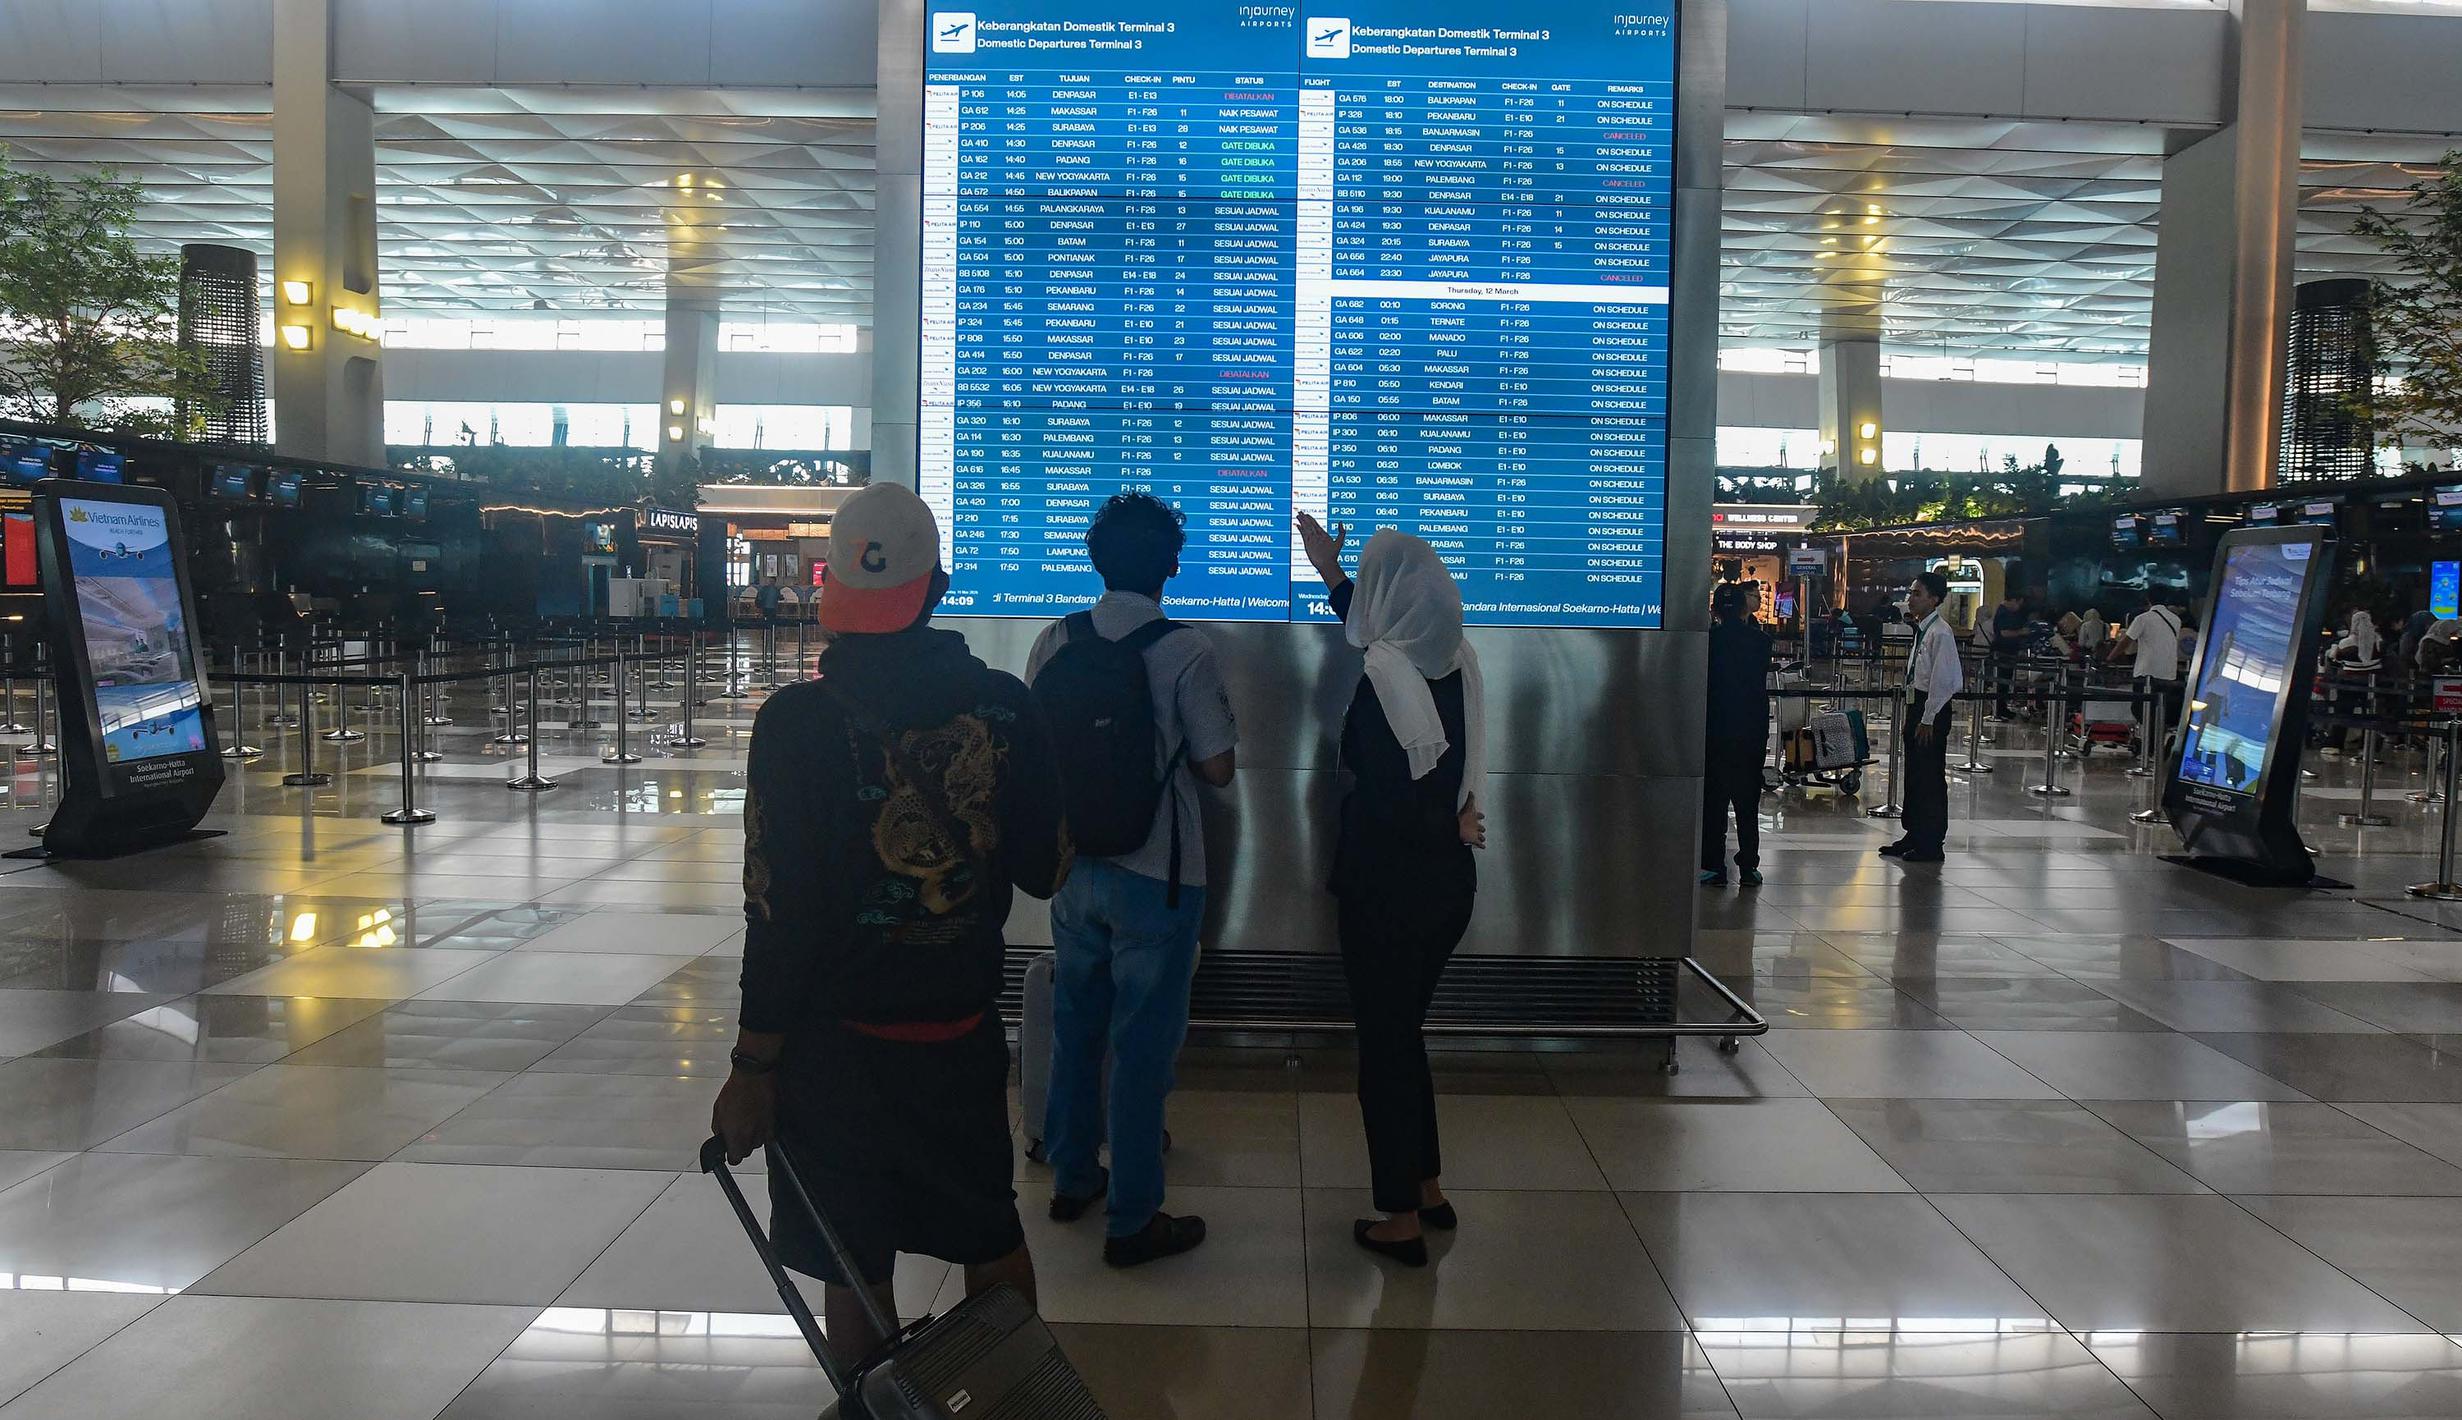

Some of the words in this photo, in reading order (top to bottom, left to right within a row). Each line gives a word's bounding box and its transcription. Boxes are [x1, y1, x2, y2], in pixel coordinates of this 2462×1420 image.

[977, 21, 1061, 33] Keberangkatan
[1063, 21, 1115, 32] Domestik
[1118, 22, 1165, 33] Terminal
[1167, 23, 1175, 33] 3
[1351, 26, 1436, 39] Keberangkatan
[1438, 28, 1490, 39] Domestik
[1493, 29, 1540, 40] Terminal
[1541, 30, 1550, 40] 3
[1615, 29, 1666, 37] AIRPORTS
[977, 38, 1026, 48] Domestic
[1028, 39, 1087, 50] Departures
[1089, 39, 1132, 49] Terminal
[1134, 40, 1142, 49] 3
[1351, 44, 1400, 54] Domestic
[1403, 45, 1461, 56] Departures
[1463, 46, 1507, 56] Terminal
[1509, 47, 1517, 57] 3
[1009, 74, 1024, 82] EST
[1428, 81, 1476, 89] DESTINATION
[1608, 85, 1644, 93] REMARKS
[1052, 91, 1096, 99] DENPASAR
[1427, 96, 1476, 104] BALIKPAPAN
[1597, 100, 1610, 108] ON
[1611, 101, 1653, 109] SCHEDULE
[1051, 107, 1097, 115] MAKASSAR
[1219, 109, 1238, 117] NAIK
[1240, 109, 1278, 117] PESAWAT
[1427, 112, 1476, 120] PEKANBARU
[1052, 123, 1095, 131] SURABAYA
[1423, 128, 1480, 136] BANJARMASIN
[1052, 140, 1095, 148] DENPASAR
[1430, 144, 1472, 152] DENPASAR
[1056, 156, 1090, 164] PADANG
[1435, 160, 1487, 168] YOGYAKARTA
[1036, 172, 1056, 180] NEW
[1057, 172, 1110, 180] YOGYAKARTA
[1426, 176, 1475, 184] PALEMBANG
[1040, 205, 1104, 213] PALANGKARAYA
[1424, 207, 1475, 215] KUALANAMU
[1050, 221, 1094, 229] DENPASAR
[1428, 223, 1471, 231] DENPASAR
[1428, 239, 1470, 247] SURABAYA
[1048, 254, 1095, 262] PONTIANAK
[1050, 270, 1093, 278] DENPASAR
[1428, 270, 1469, 278] JAYAPURA
[1046, 286, 1096, 294] PEKANBARU
[1047, 303, 1094, 311] SEMARANG
[1431, 302, 1465, 310] SORONG
[1046, 319, 1096, 327] PEKANBARU
[1213, 321, 1242, 329] SESUAI
[1243, 322, 1277, 330] JADWAL
[1431, 318, 1465, 326] TERNATE
[1047, 335, 1094, 343] MAKASSAR
[1048, 352, 1092, 360] DENPASAR
[1437, 349, 1457, 357] PALU
[1606, 353, 1647, 361] SCHEDULE
[1002, 367, 1023, 375] 16:00
[1054, 368, 1107, 376] YOGYAKARTA
[1424, 365, 1469, 373] MAKASSAR
[1032, 384, 1052, 392] NEW
[1054, 384, 1107, 392] YOGYAKARTA
[1429, 381, 1463, 389] KENDARI
[1052, 400, 1087, 408] PADANG
[1377, 413, 1400, 421] 06:00
[1423, 414, 1468, 422] MAKASSAR
[1047, 418, 1090, 426] SURABAYA
[1043, 434, 1094, 442] PALEMBANG
[1420, 430, 1471, 438] KUALANAMU
[1428, 446, 1462, 454] PADANG
[1042, 451, 1094, 459] KUALANAMU
[1416, 477, 1473, 485] BANJARMASIN
[1047, 483, 1089, 491] SURABAYA
[1423, 493, 1465, 501] SURABAYA
[1001, 498, 1020, 506] 17:00
[1046, 499, 1090, 507] DENPASAR
[1420, 509, 1468, 517] PEKANBARU
[87, 511, 127, 525] Vietnam
[128, 514, 160, 528] Airlines
[650, 512, 698, 531] LAPISLAPIS
[1046, 515, 1089, 523] SURABAYA
[1768, 514, 1798, 523] CENTER
[1419, 524, 1468, 532] PALEMBANG
[1588, 527, 1601, 535] ON
[1602, 528, 1643, 536] SCHEDULE
[1044, 531, 1087, 540] SEMARAN
[1430, 540, 1464, 548] URABAYA
[1718, 540, 1733, 549] THE
[1735, 541, 1756, 549] BODY
[1757, 542, 1777, 550] SHOP
[1047, 548, 1088, 556] LAMPUNG
[1041, 564, 1092, 572] PALEMBANG
[1208, 567, 1237, 575] SESUAI
[1238, 567, 1272, 575] JADWAL
[941, 596, 973, 606] 14:09
[1004, 593, 1044, 603] Terminal
[1046, 594, 1053, 603] 3
[1055, 594, 1097, 604] Bandara
[1162, 596, 1241, 606] Soekarno-Hatta
[1307, 602, 1337, 615] 14:
[1461, 602, 1497, 610] andara
[1499, 602, 1561, 612] Internasional
[1562, 603, 1640, 614] Soekarno-Hatta
[129, 771, 172, 783] International
[173, 767, 195, 778] Airport
